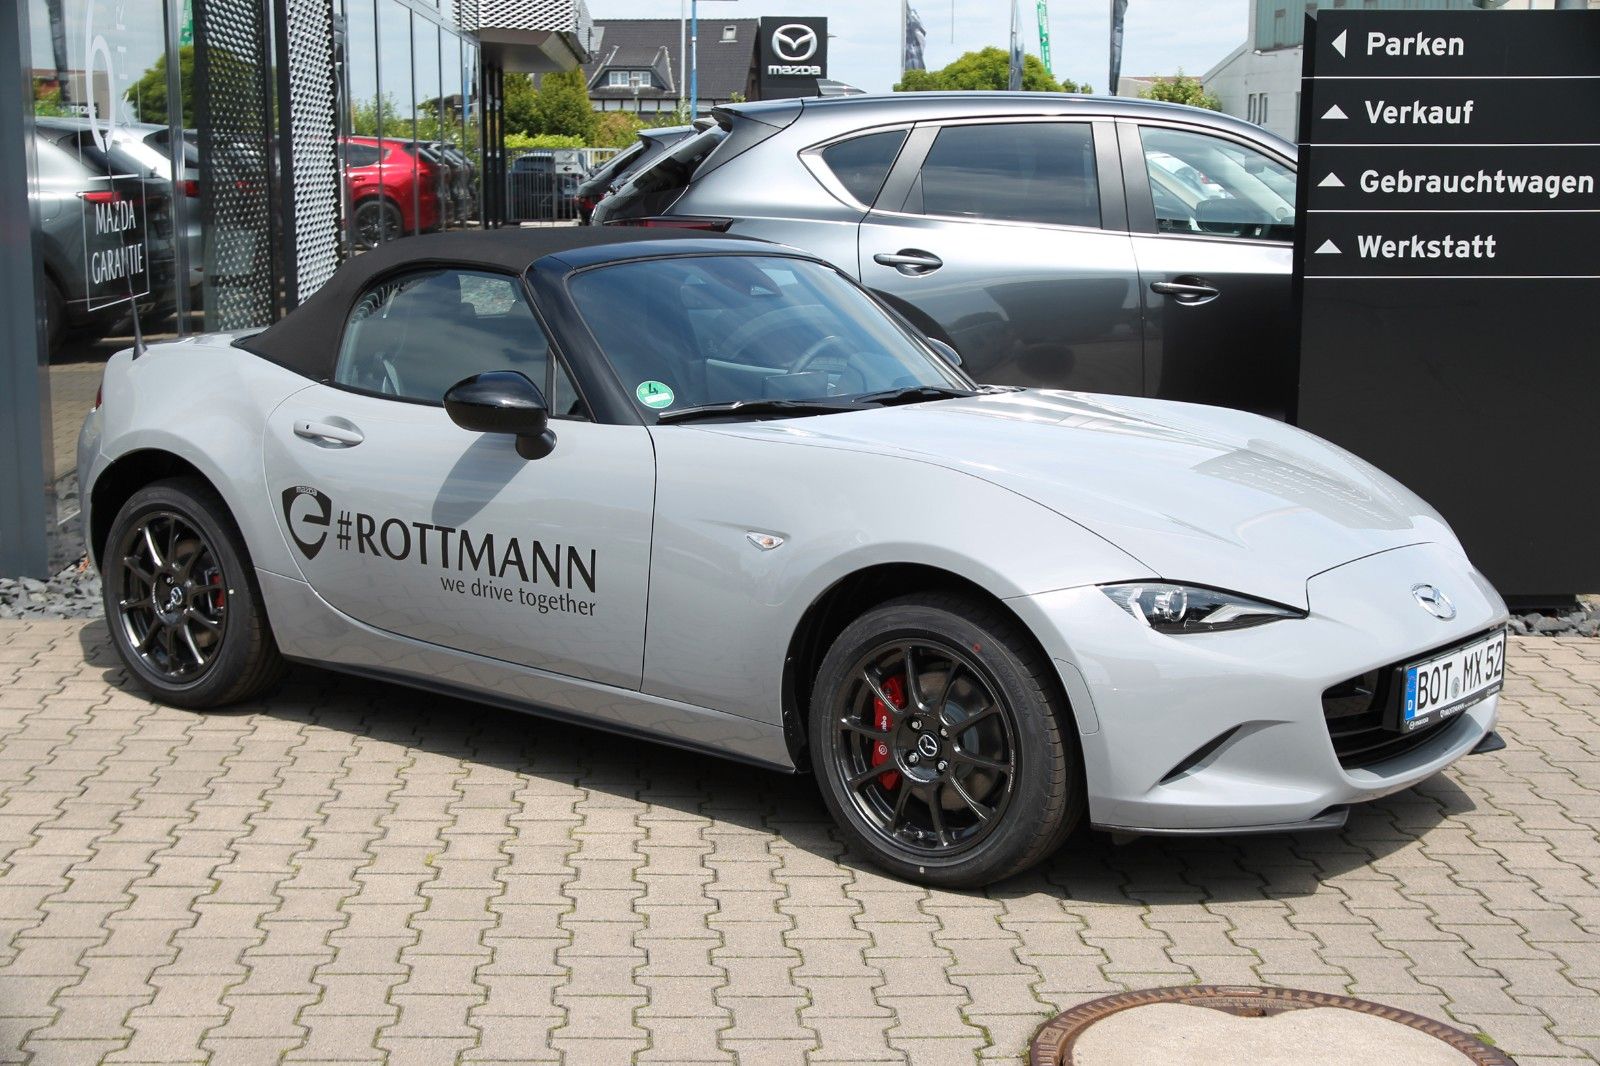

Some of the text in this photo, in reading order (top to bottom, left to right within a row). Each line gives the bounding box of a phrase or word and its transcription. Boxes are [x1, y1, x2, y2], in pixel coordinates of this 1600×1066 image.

[1366, 31, 1465, 56] Parken
[767, 64, 822, 76] mazda
[1364, 99, 1474, 125] Verkauf
[1359, 169, 1594, 199] Gebrauchtwagen
[95, 199, 137, 235] MAZDA
[1357, 234, 1497, 259] Werkstatt
[91, 242, 144, 285] GARANTIE
[336, 509, 598, 594] #ROTTMANN
[440, 576, 597, 617] we drive together
[1417, 640, 1503, 710] BOT MX 52
